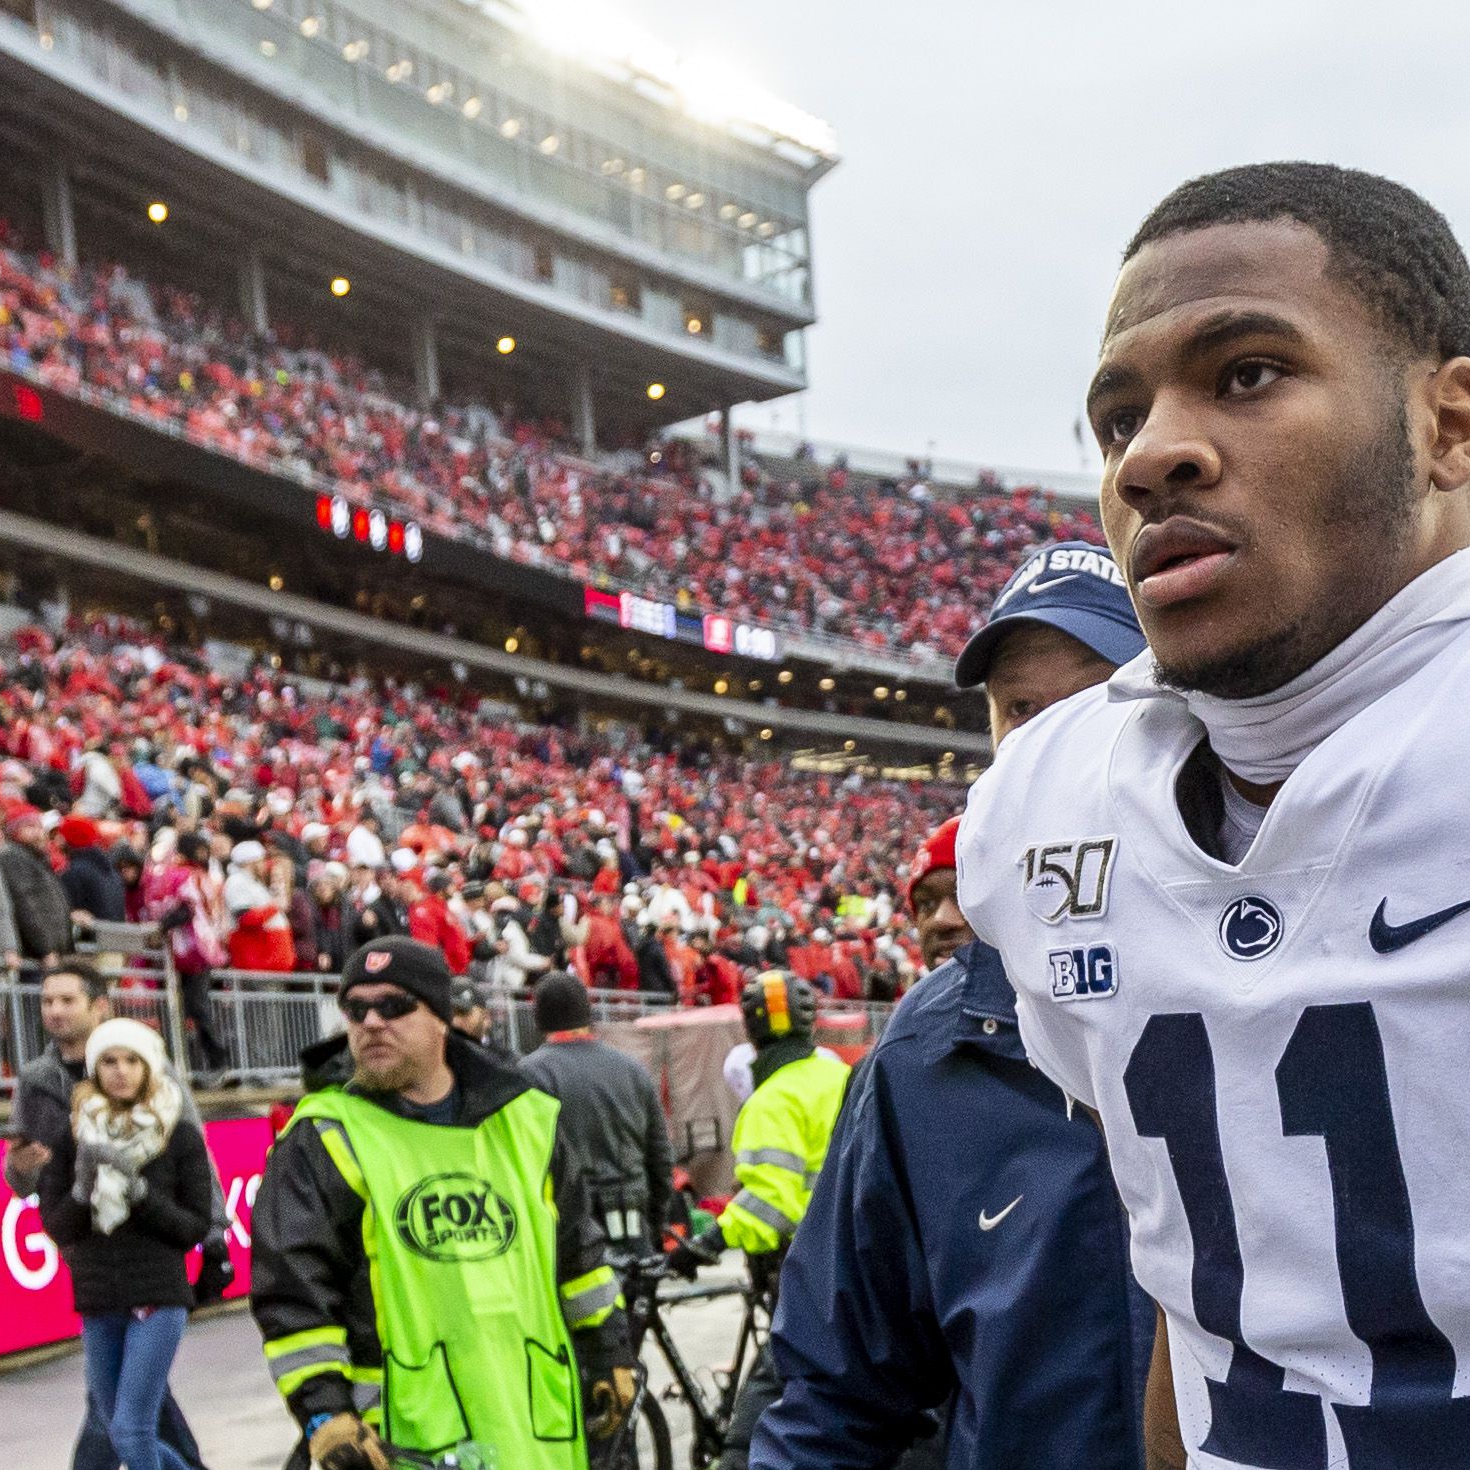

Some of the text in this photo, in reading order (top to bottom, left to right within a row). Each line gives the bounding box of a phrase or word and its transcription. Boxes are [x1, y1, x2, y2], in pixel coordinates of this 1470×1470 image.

[1021, 838, 1116, 923] 150
[421, 1181, 496, 1231] FOX
[426, 1226, 503, 1248] SPORTS
